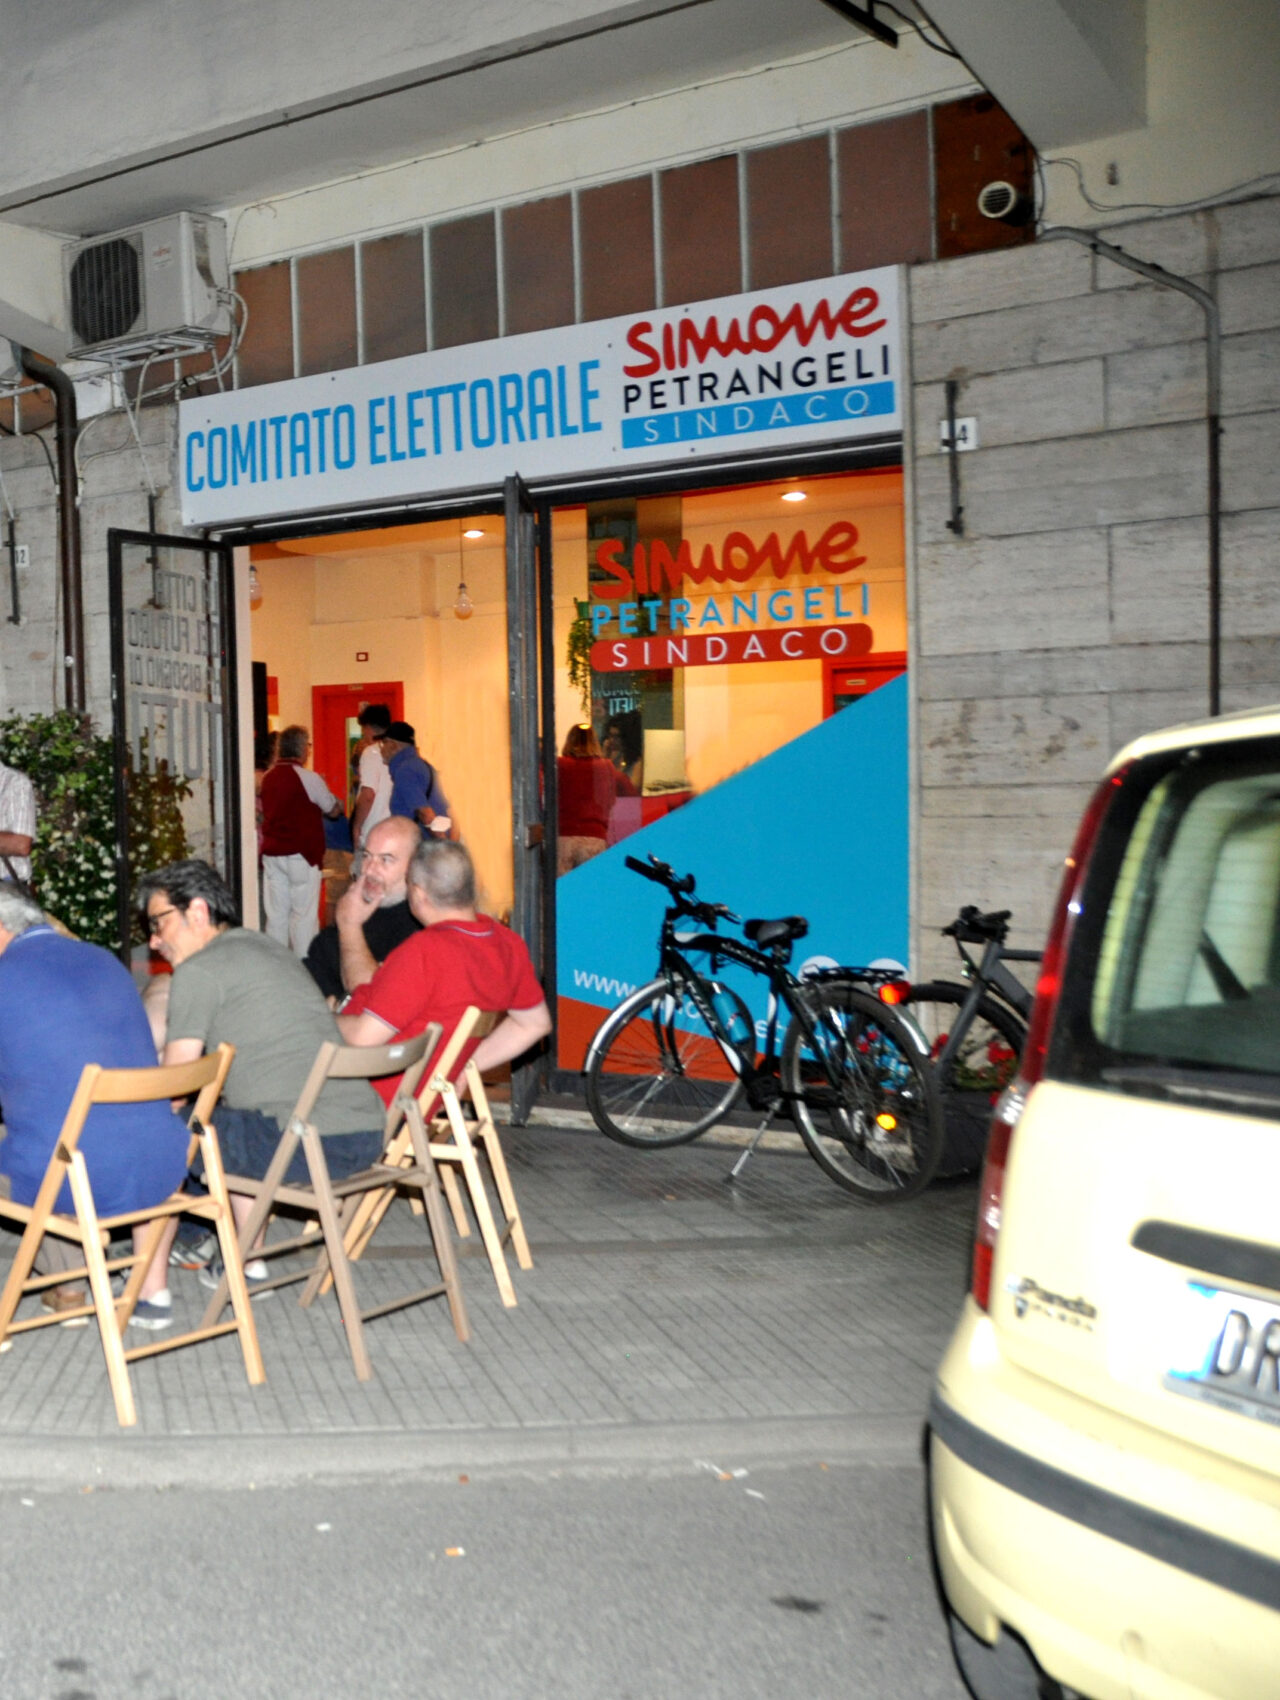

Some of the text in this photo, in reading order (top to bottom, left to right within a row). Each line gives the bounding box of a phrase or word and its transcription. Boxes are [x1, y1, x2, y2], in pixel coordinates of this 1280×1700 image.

[623, 344, 889, 414] PETRANGELI
[186, 359, 603, 493] COMITATO ELETTORALE
[643, 389, 870, 443] SINDACO
[592, 582, 870, 636] PETRANGELI
[611, 628, 848, 668] SINDACO
[1017, 1276, 1097, 1320] Panda
